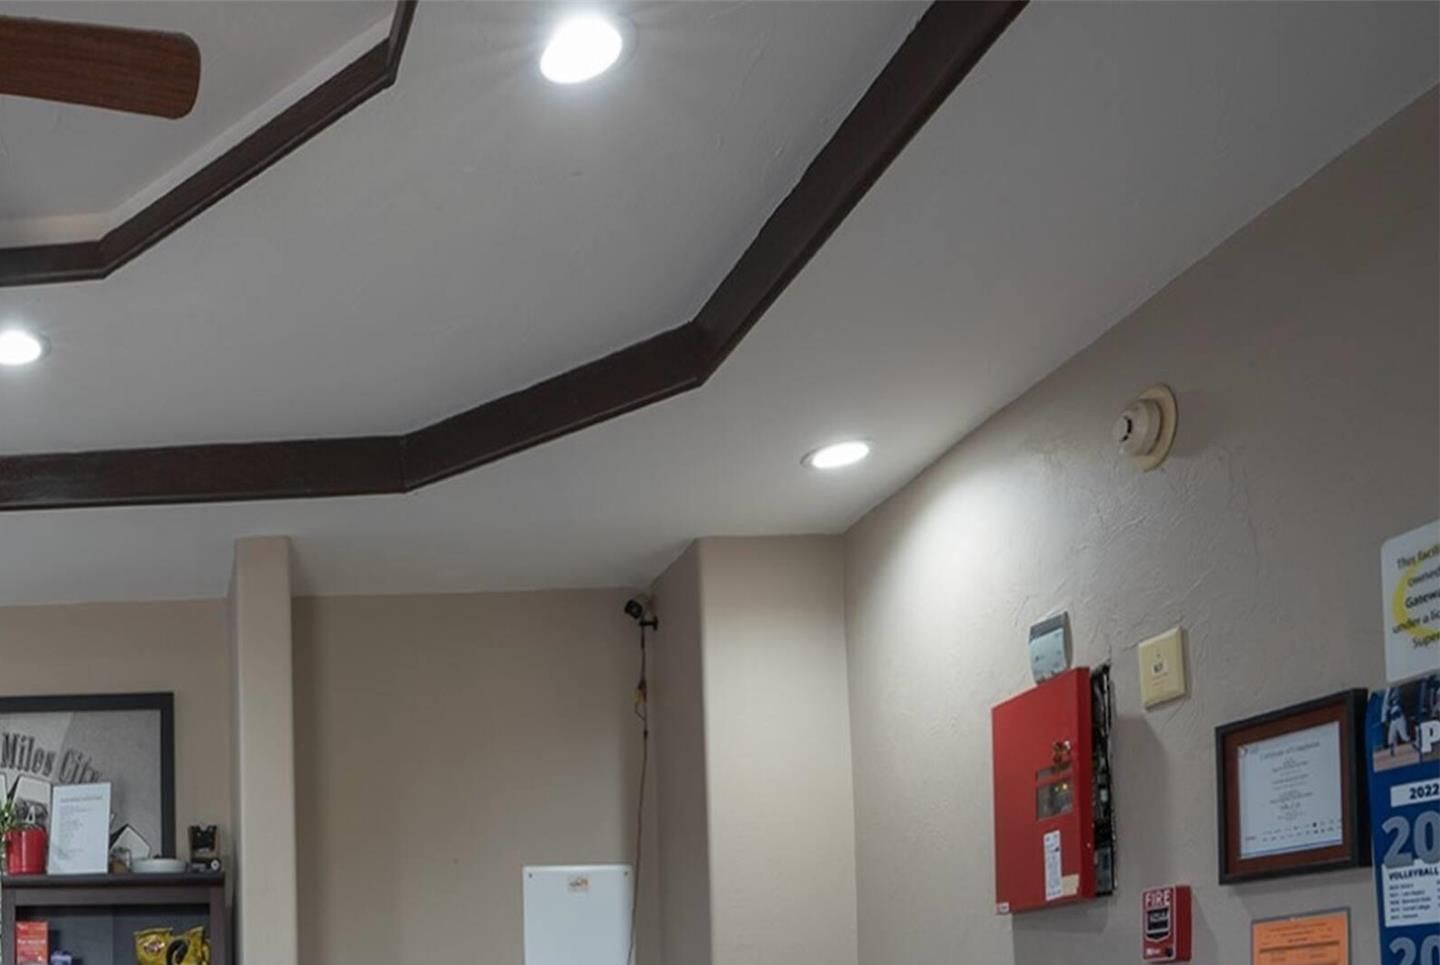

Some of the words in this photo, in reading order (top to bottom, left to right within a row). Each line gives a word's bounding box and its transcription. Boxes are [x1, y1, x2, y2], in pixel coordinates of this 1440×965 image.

[1, 733, 55, 775] Miles
[1389, 866, 1439, 881] VOLLEYBALL
[1145, 889, 1171, 908] FIRE
